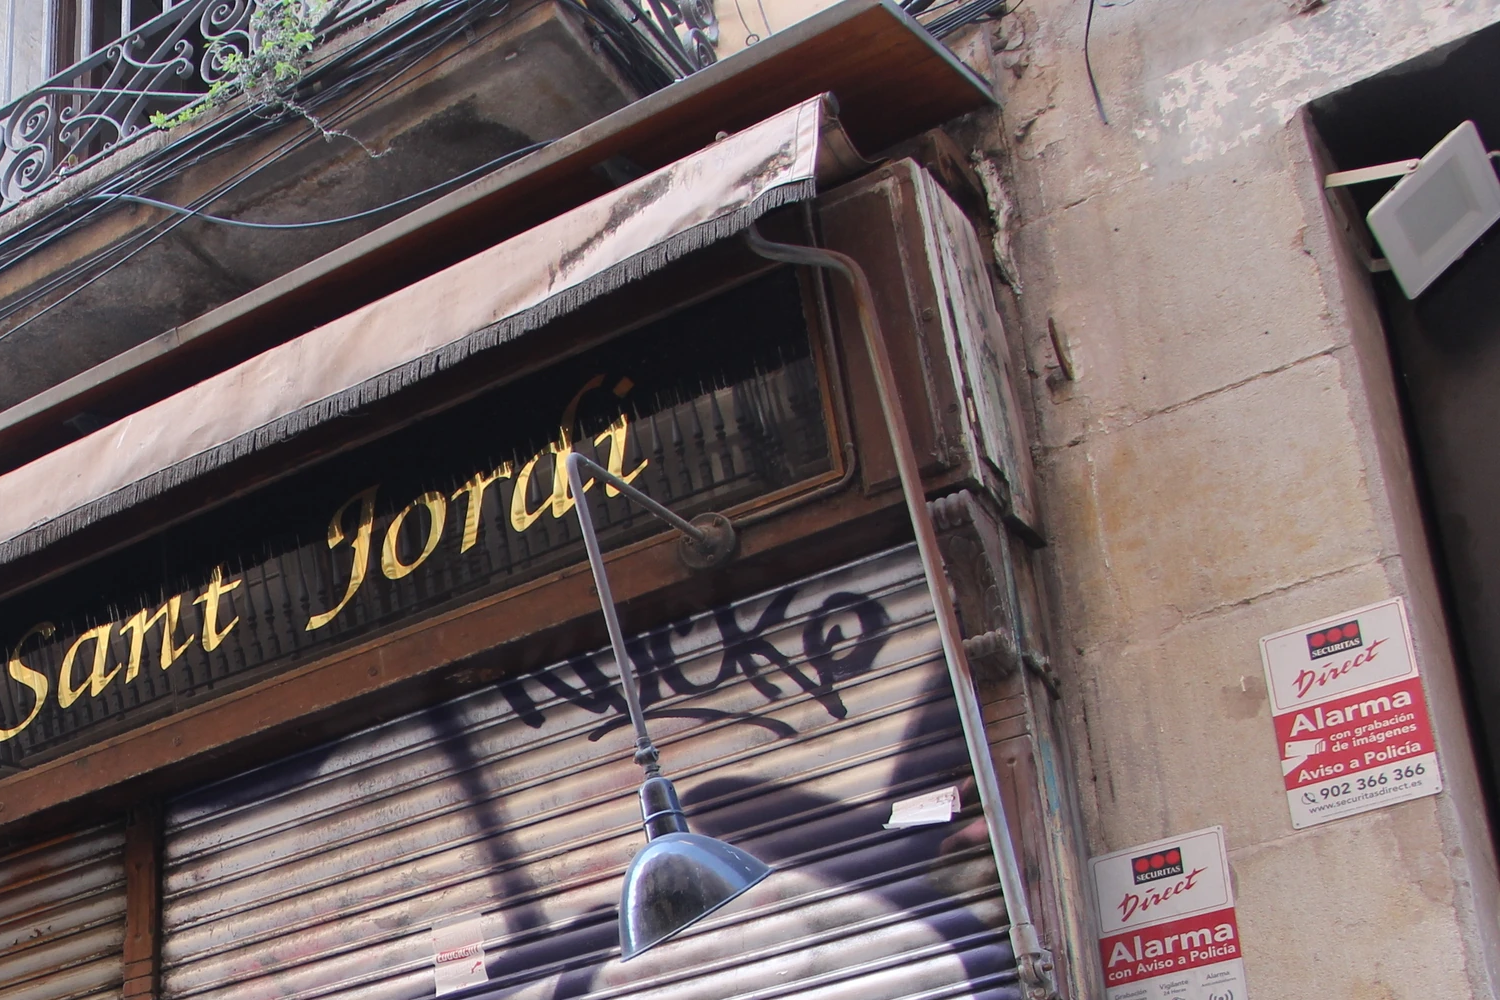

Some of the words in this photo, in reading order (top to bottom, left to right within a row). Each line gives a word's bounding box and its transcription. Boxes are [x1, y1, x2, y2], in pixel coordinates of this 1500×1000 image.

[305, 374, 649, 632] Jordi
[1311, 637, 1361, 658] SECURITAS
[1292, 637, 1390, 698] Direct
[1290, 690, 1412, 737] Alarma
[1329, 729, 1352, 741] con
[1354, 712, 1415, 738] grabación
[1331, 741, 1349, 753] de
[1352, 722, 1417, 748] imágenes
[1297, 763, 1345, 783] Aviso
[1349, 757, 1360, 769] a
[1364, 741, 1422, 765] Policía
[1308, 779, 1423, 814] www.securitasdirect.es
[1319, 783, 1352, 800] 902
[1355, 773, 1388, 791] 366
[1392, 763, 1426, 782] 366
[1136, 865, 1182, 883] SECURITAS
[1117, 866, 1209, 923] Direct
[1107, 923, 1235, 968] Alarma
[1108, 968, 1132, 981] con
[1136, 958, 1174, 975] Aviso
[1178, 955, 1187, 965] a
[1190, 943, 1236, 962] Policía
[1159, 980, 1189, 990] Vigilante
